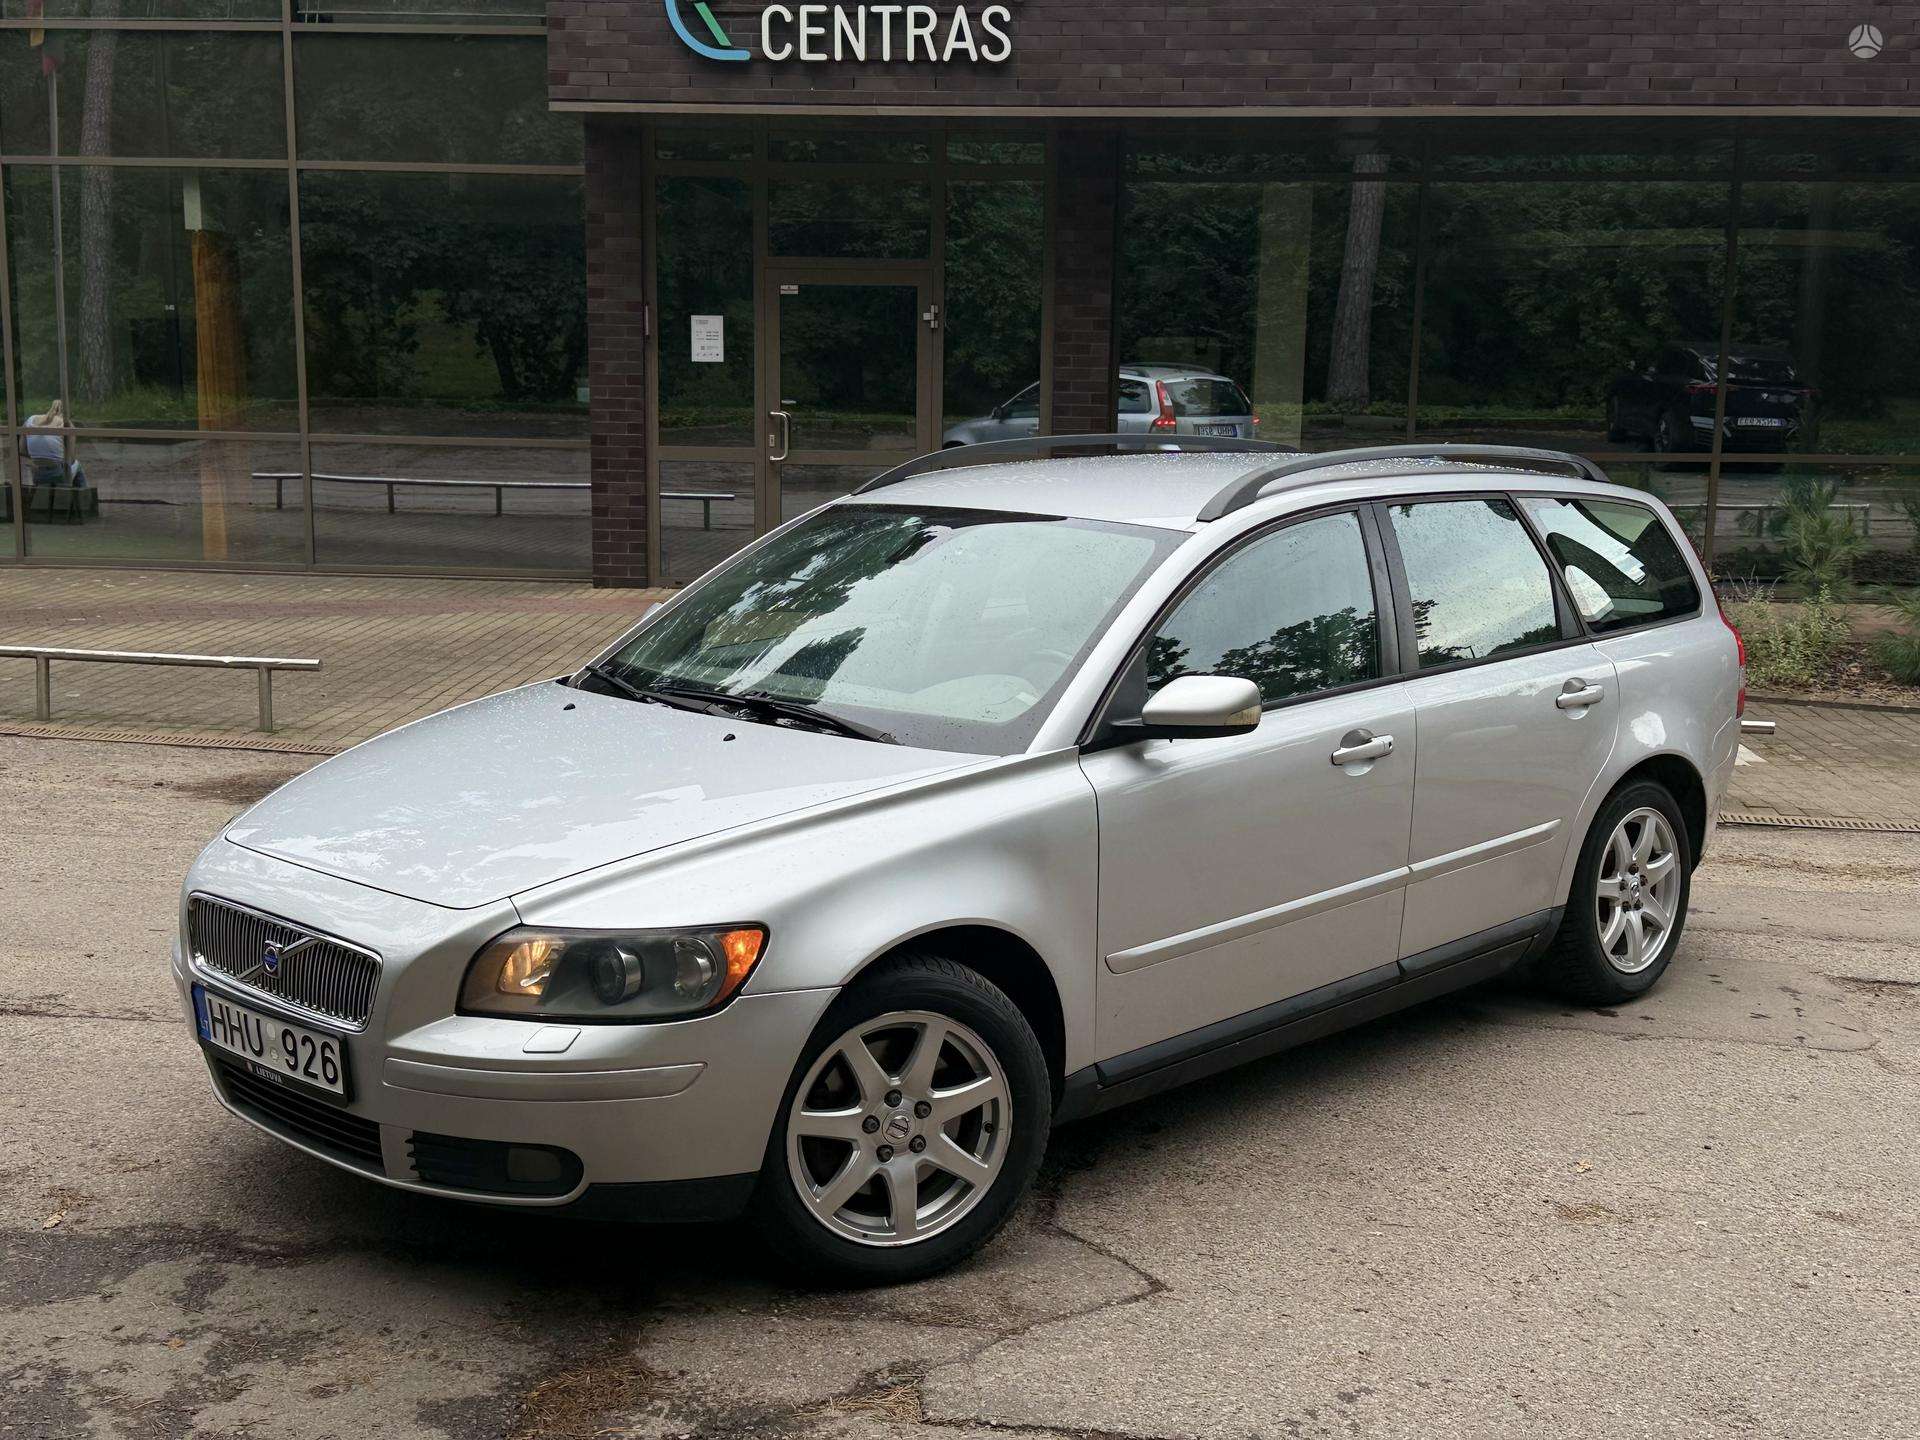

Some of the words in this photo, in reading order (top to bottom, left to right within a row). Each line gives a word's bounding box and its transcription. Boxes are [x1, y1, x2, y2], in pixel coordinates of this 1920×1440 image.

[761, 4, 1012, 62] CENTRAS
[207, 997, 264, 1058] HHU
[281, 1028, 339, 1085] 926
